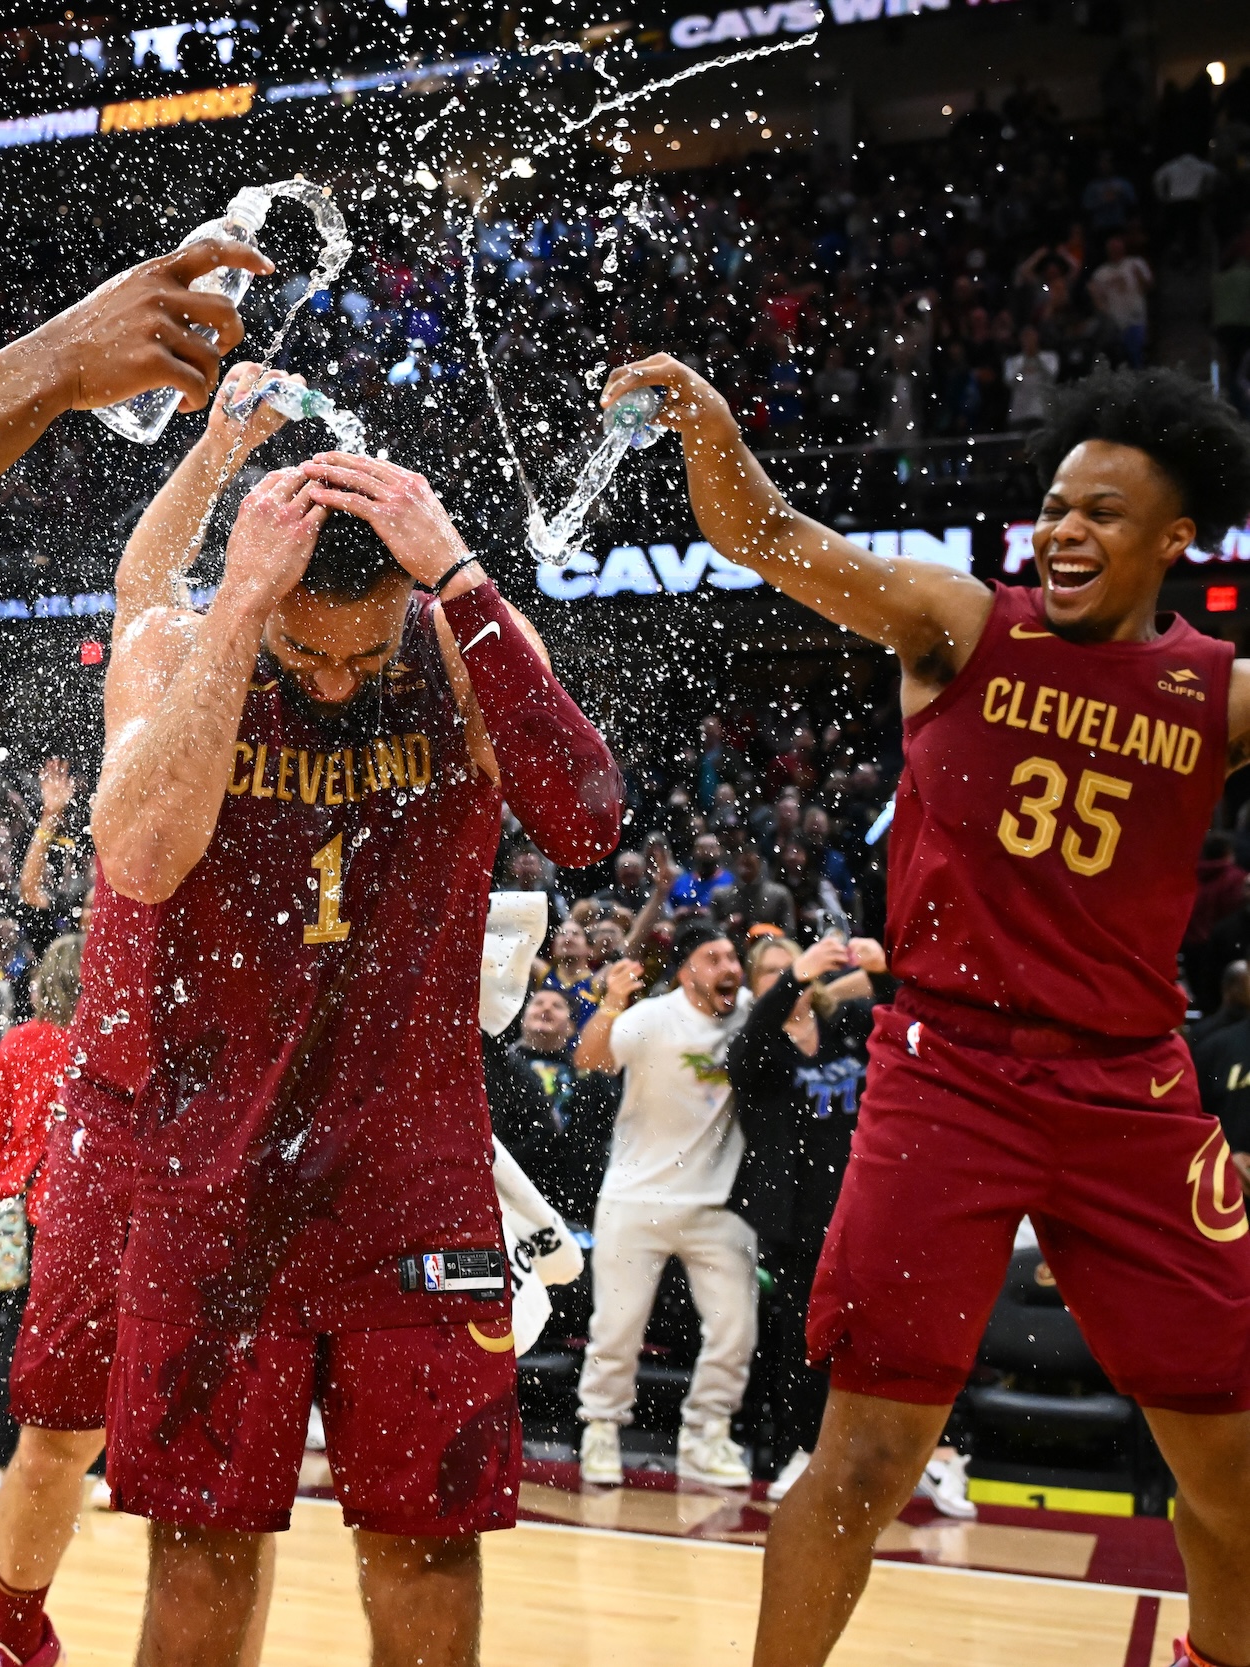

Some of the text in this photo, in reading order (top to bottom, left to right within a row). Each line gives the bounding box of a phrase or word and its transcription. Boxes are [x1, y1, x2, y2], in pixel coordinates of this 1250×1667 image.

[982, 676, 1202, 775] CLEVELAND
[1157, 680, 1205, 702] CLIFFS
[226, 732, 432, 806] CLEVELAND
[997, 756, 1133, 877] 35
[303, 831, 350, 944] 1
